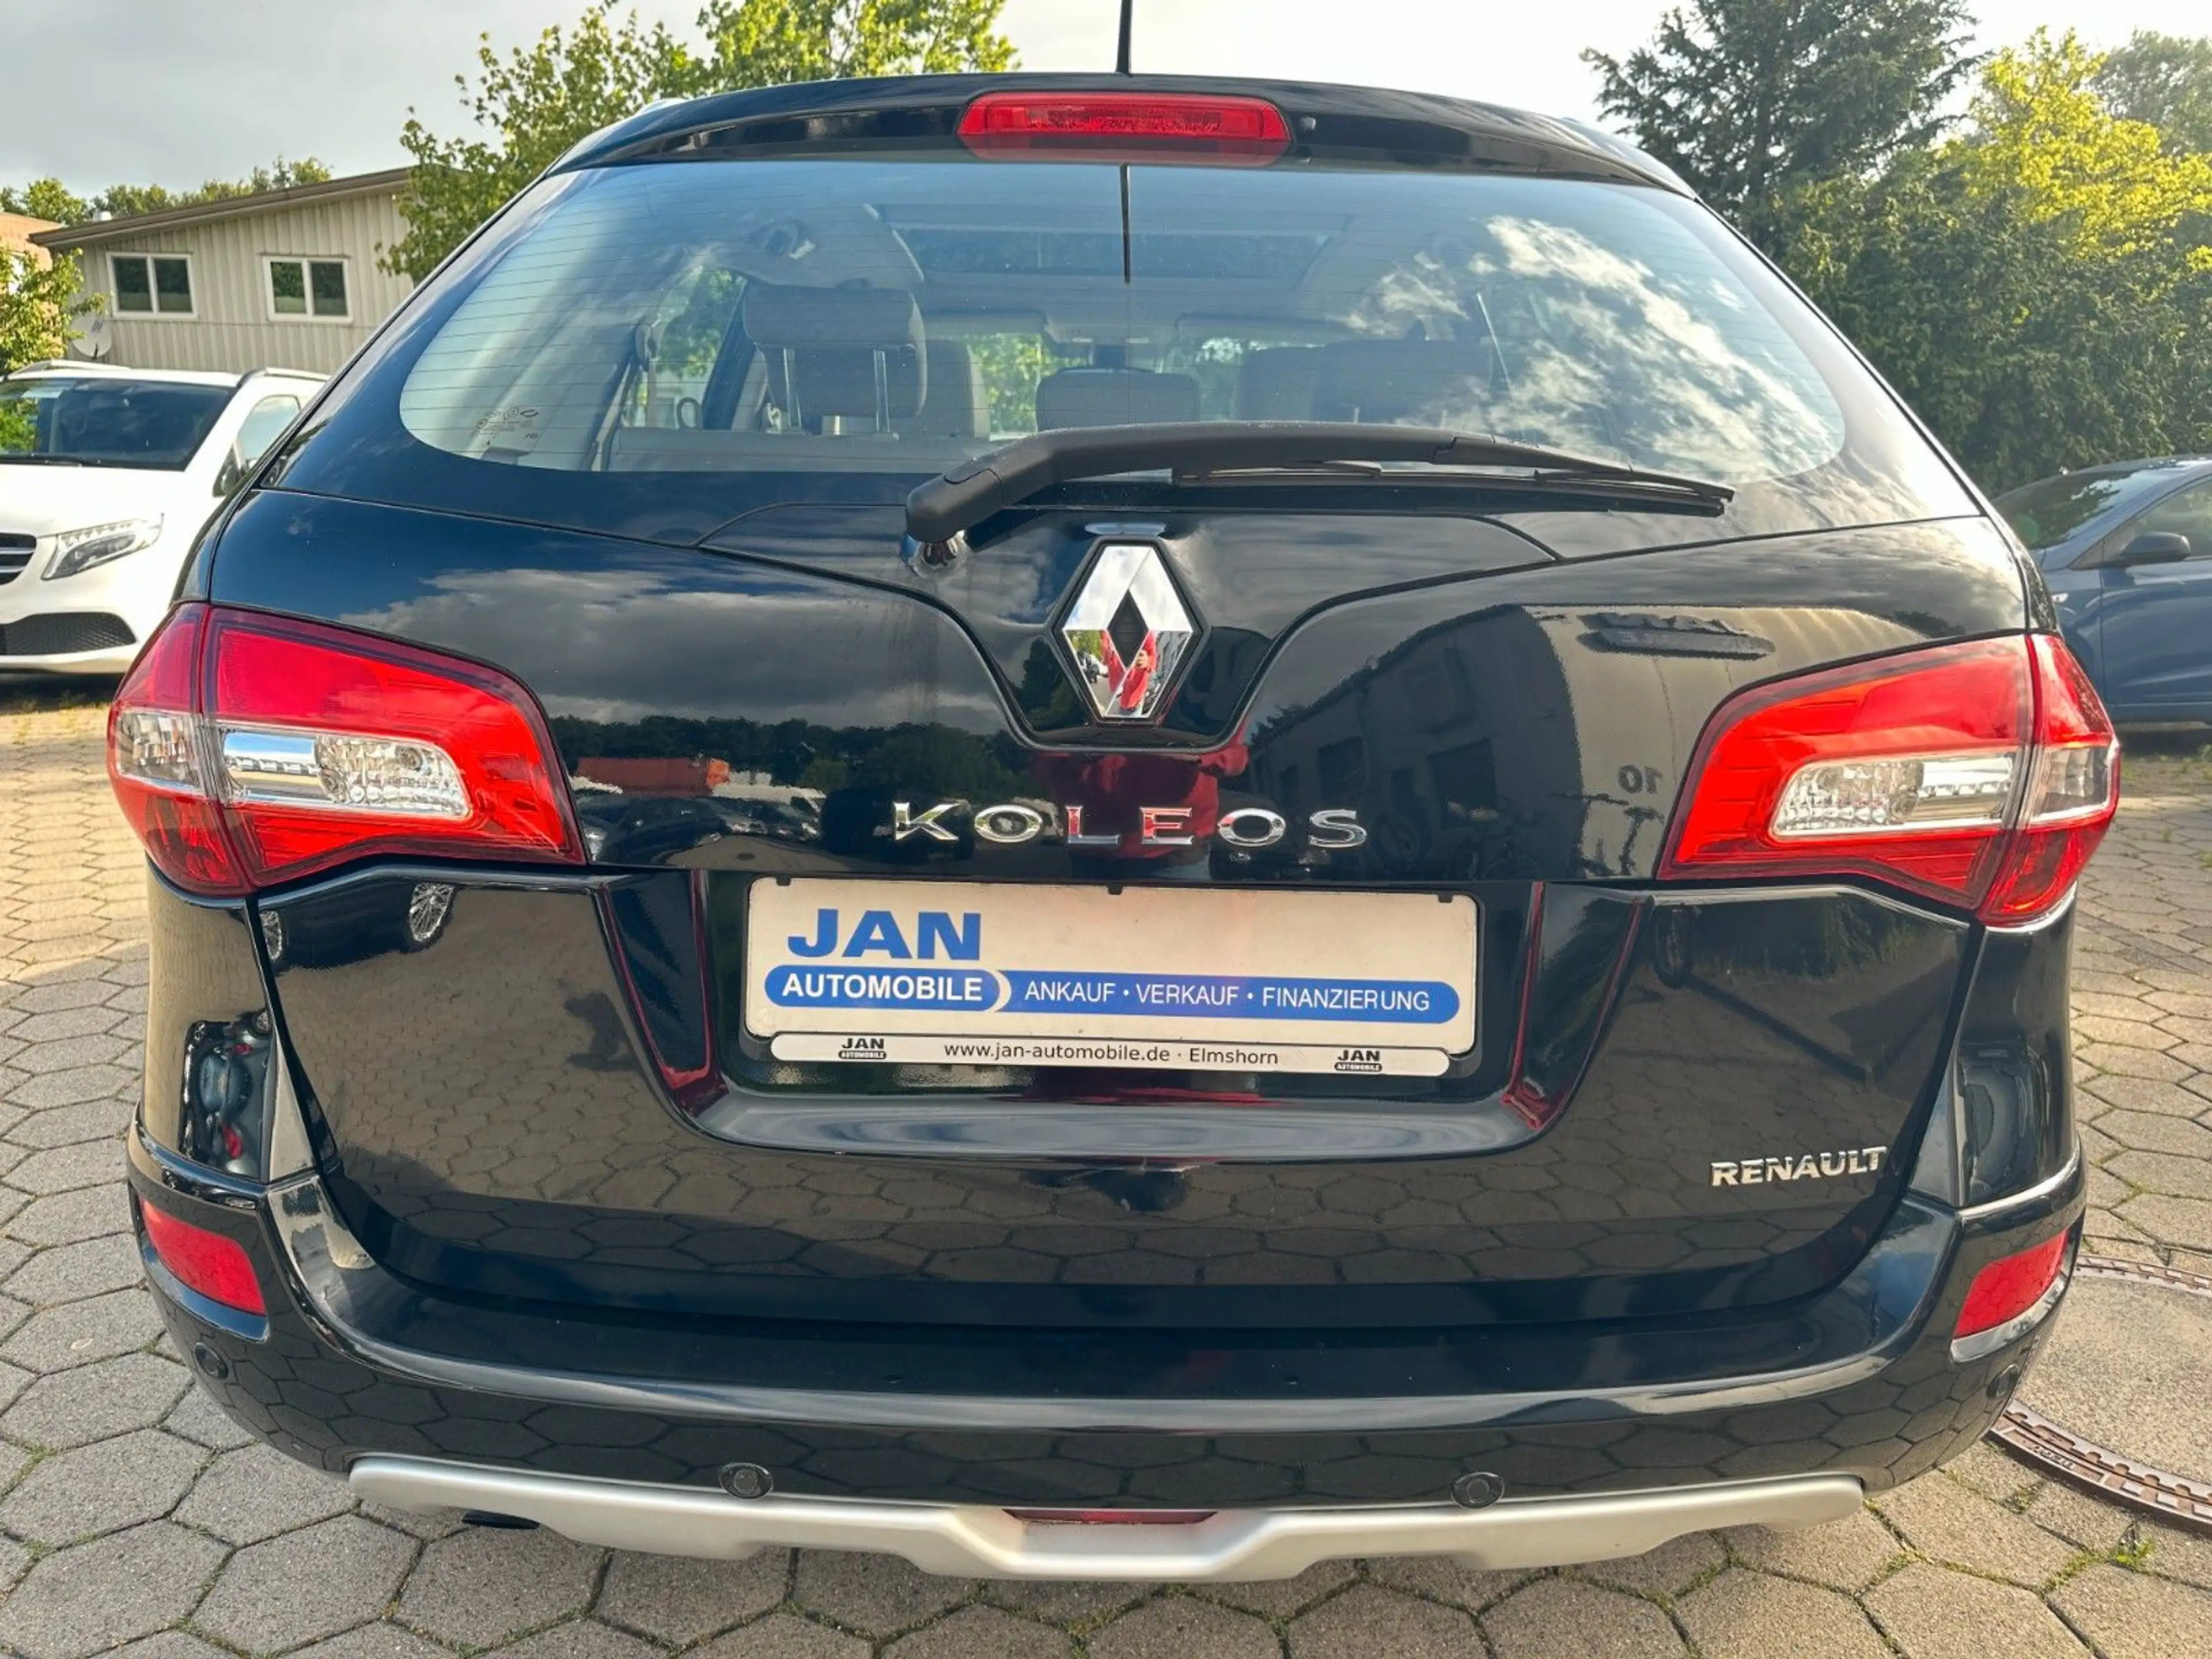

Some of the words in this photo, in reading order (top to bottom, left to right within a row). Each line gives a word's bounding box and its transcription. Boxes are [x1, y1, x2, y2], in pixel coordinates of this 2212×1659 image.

[893, 802, 1368, 848] KOLEOS
[787, 908, 982, 961] JAN
[781, 973, 983, 1001] AUTOMOBILE
[1024, 980, 1116, 1002] ANKAUF
[1136, 983, 1240, 1006] VERKAUF
[1262, 987, 1430, 1012] FINANZIERUNG
[841, 1037, 885, 1049] JAN
[944, 1042, 1171, 1061] www.jan-automobile.de
[1190, 1047, 1278, 1065] Elmshorn
[1337, 1050, 1380, 1062] JAN
[1710, 1146, 1887, 1187] RENAULT
